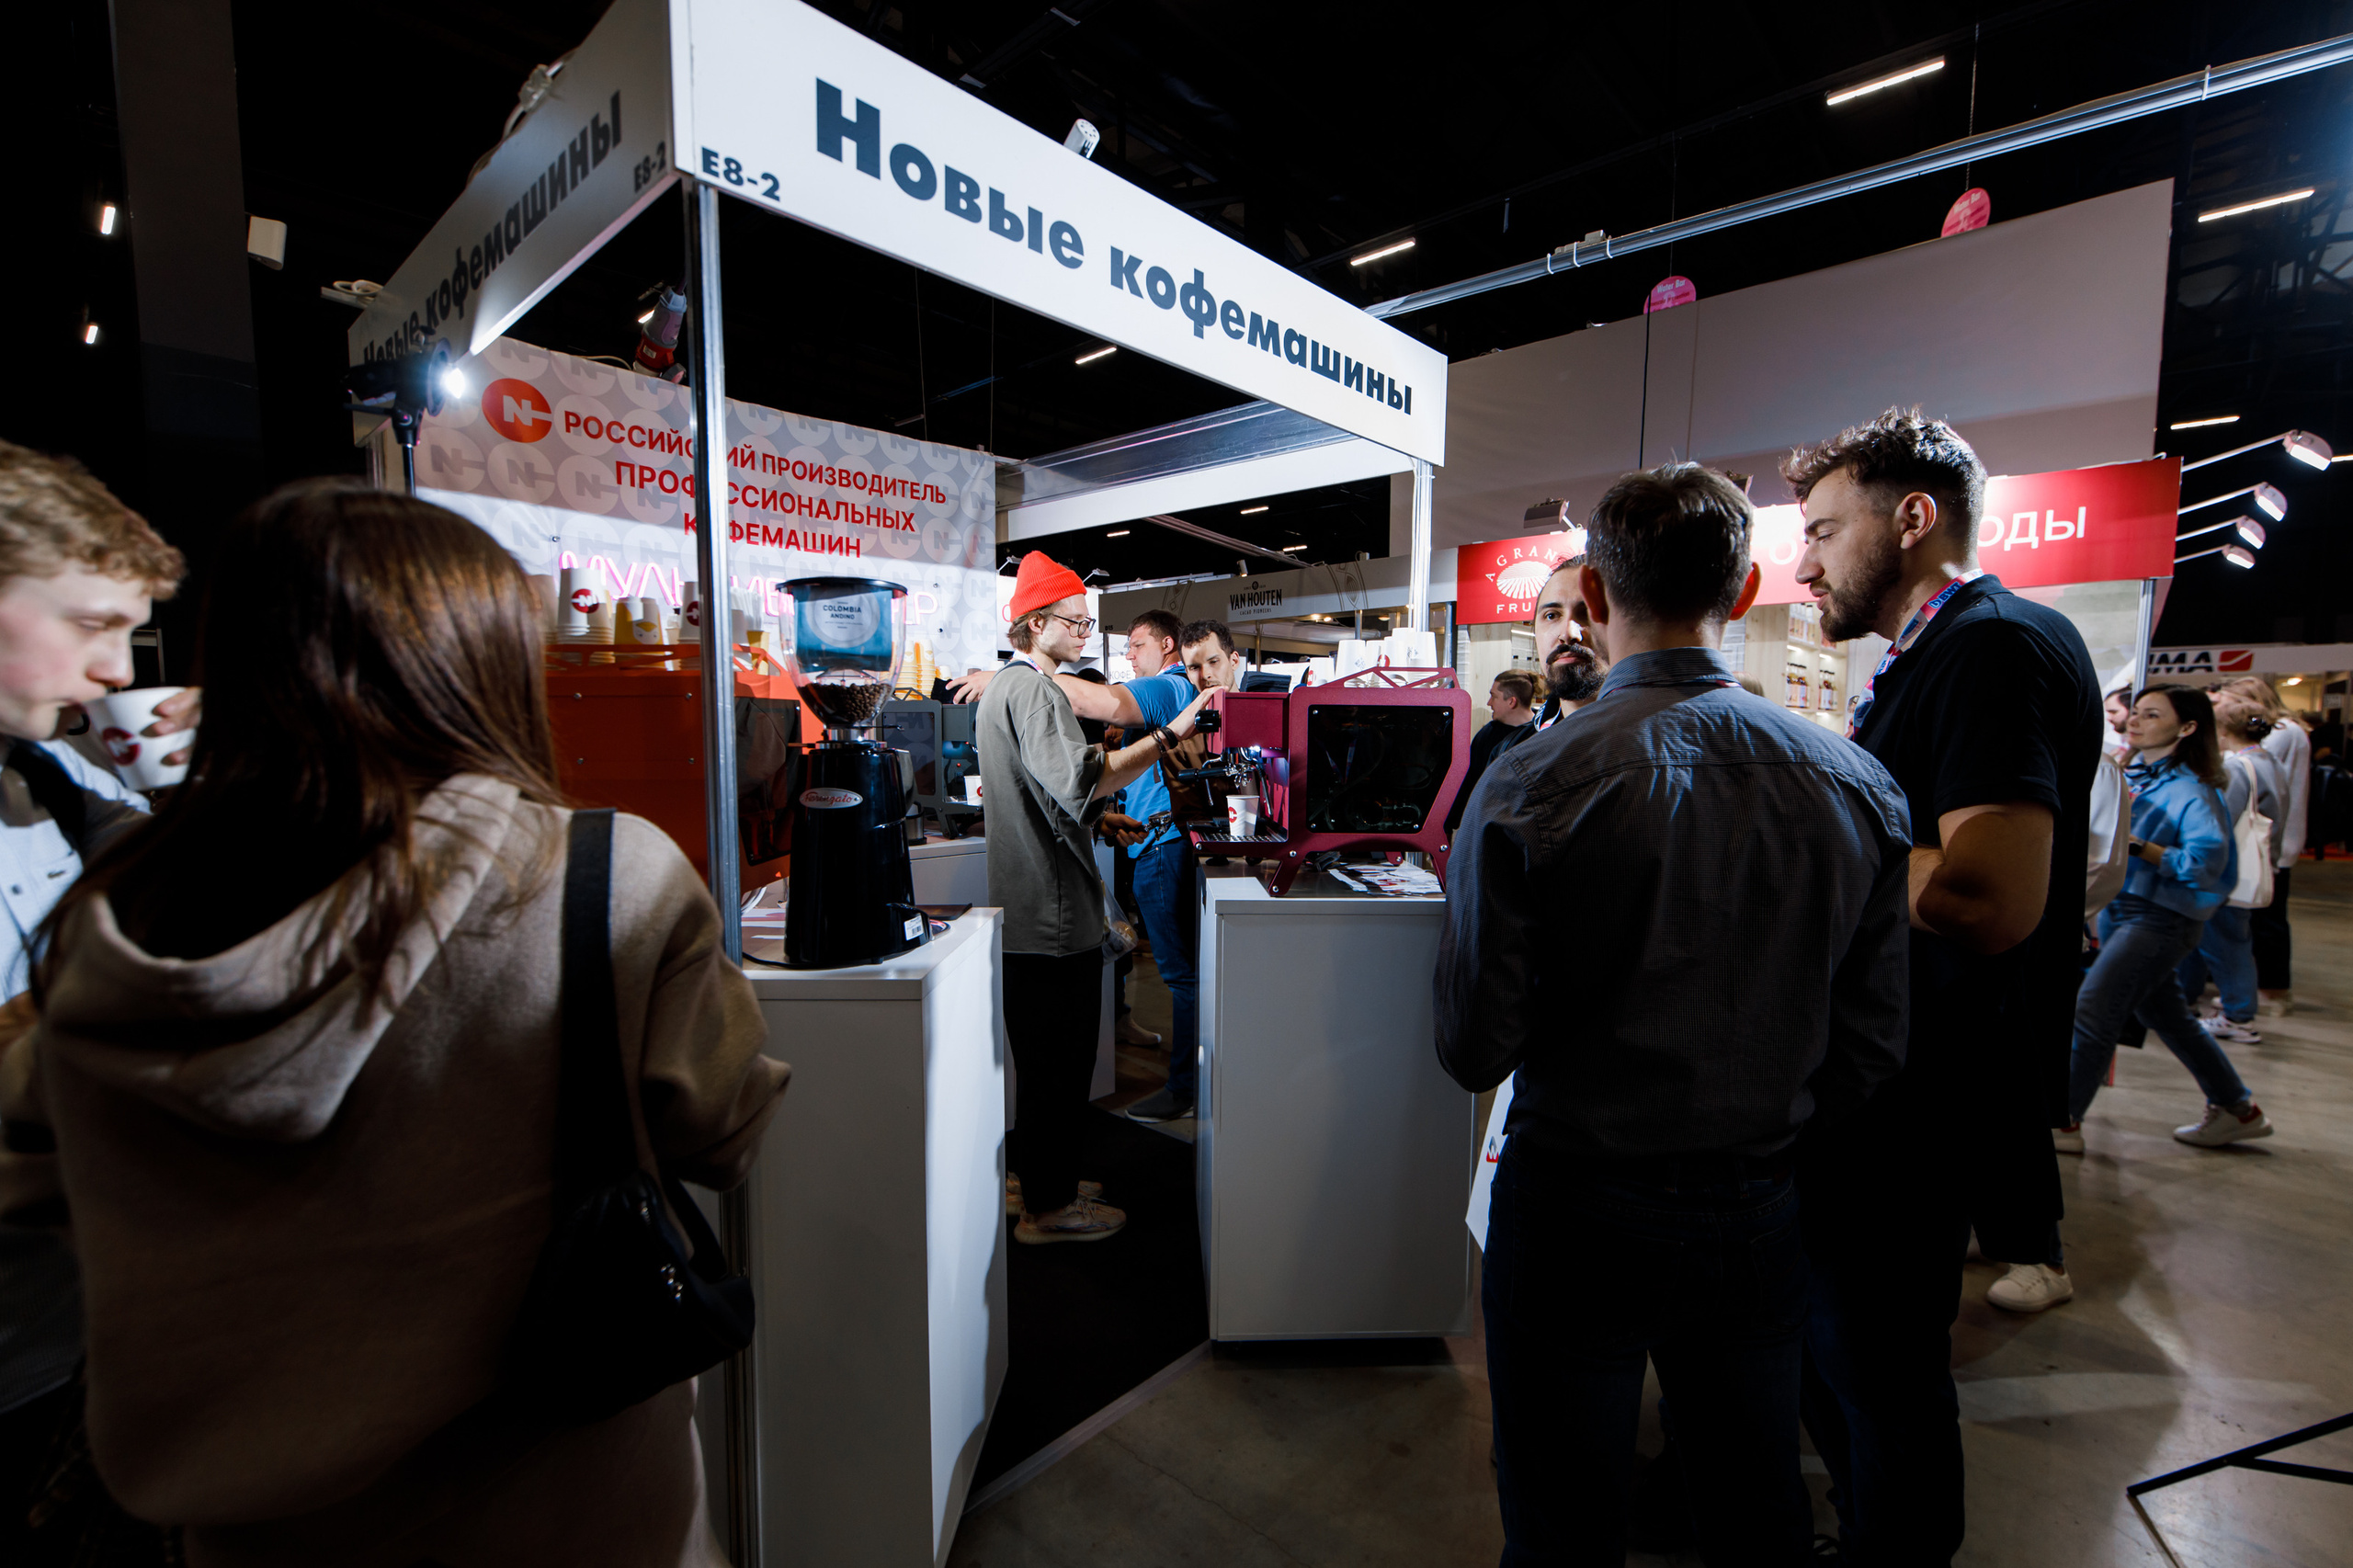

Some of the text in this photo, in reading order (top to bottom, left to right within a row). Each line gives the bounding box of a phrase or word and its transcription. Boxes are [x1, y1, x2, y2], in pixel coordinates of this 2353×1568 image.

[701, 145, 780, 202] E8-2
[426, 89, 622, 328] кофемашины
[816, 76, 1412, 416] Новые кофемашины
[564, 410, 947, 504] РОССИЙИЙ ПРОИЗВОДИТЕЛЬ
[615, 460, 915, 532] ПРОФССИОНАЛЬНЫХ
[684, 512, 861, 559] КФЕМАШИН
[1485, 545, 1558, 582] AGRAN
[823, 605, 862, 613] COLOMBIA
[1230, 588, 1282, 611] VAN HOUTEN
